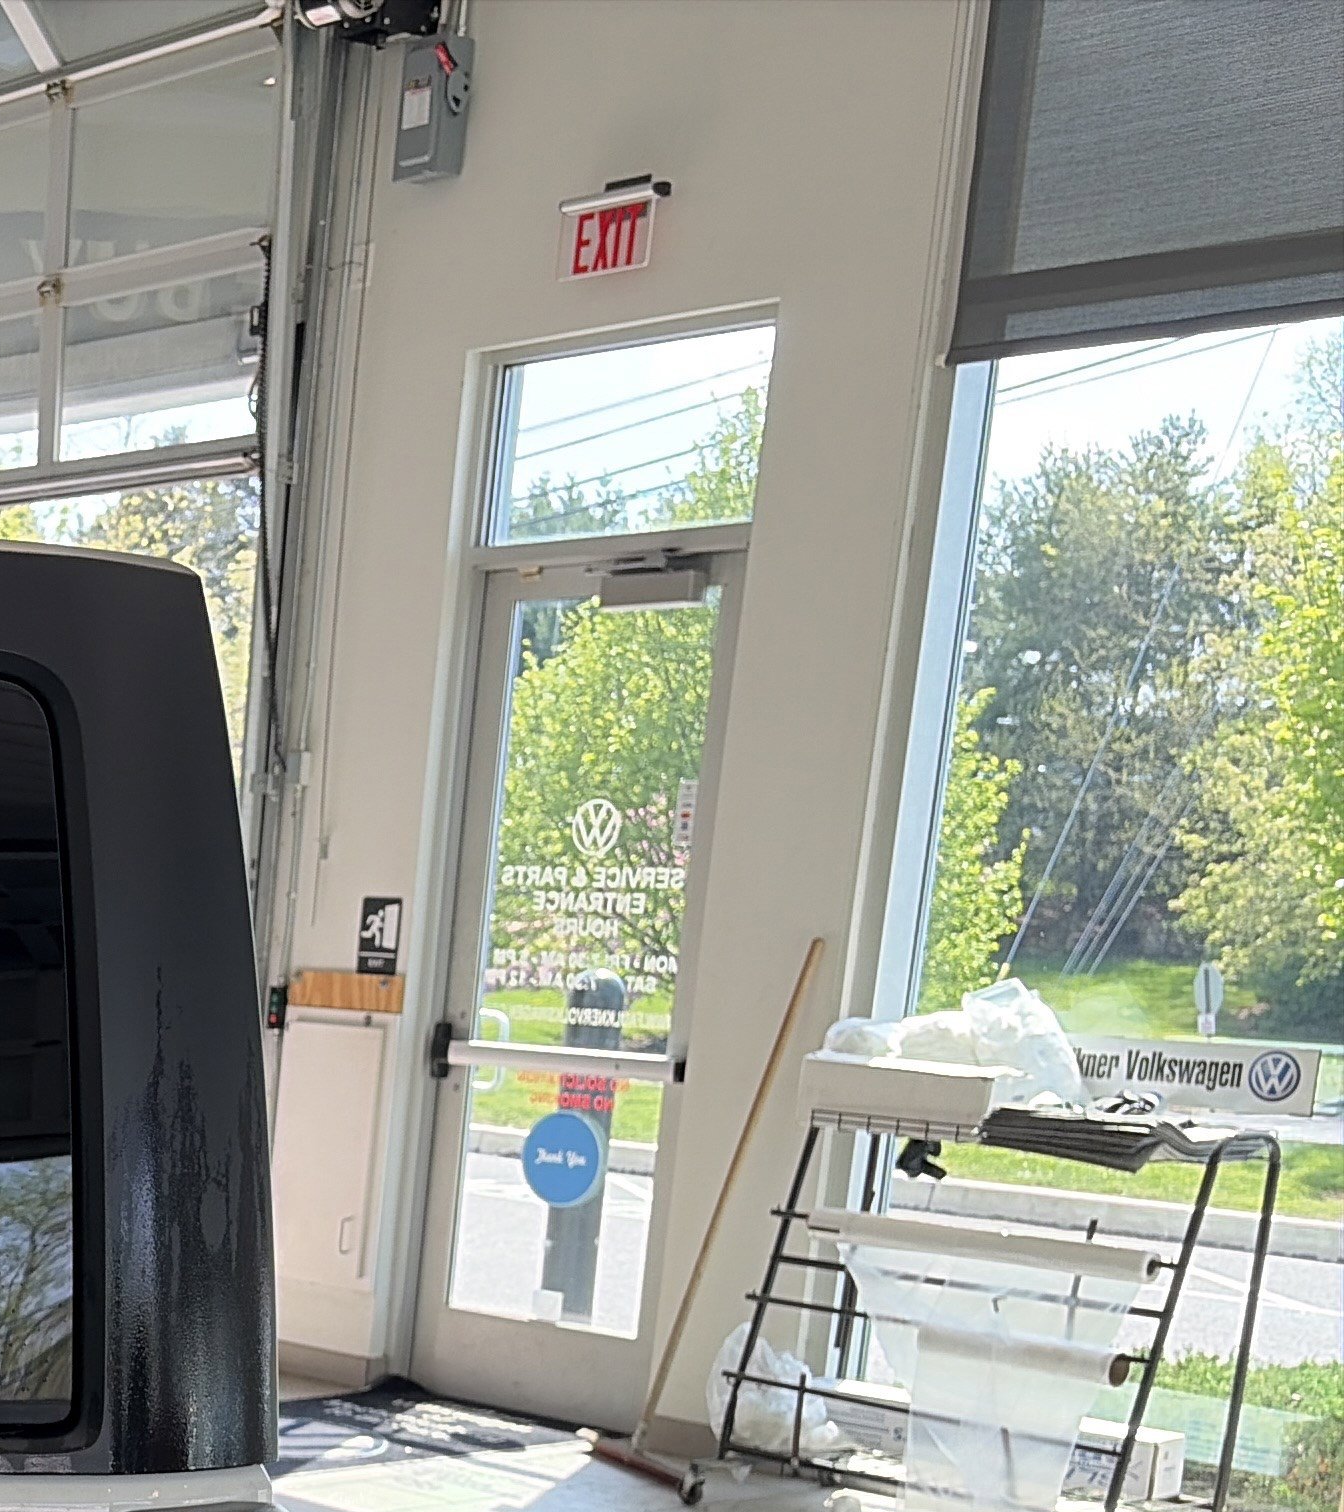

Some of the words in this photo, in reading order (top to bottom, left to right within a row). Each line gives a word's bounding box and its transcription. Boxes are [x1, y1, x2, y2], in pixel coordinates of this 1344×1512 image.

[572, 201, 648, 275] EXIT
[1126, 1048, 1244, 1091] Volkswagen
[534, 1147, 563, 1165] Thank
[565, 1150, 587, 1169] You
